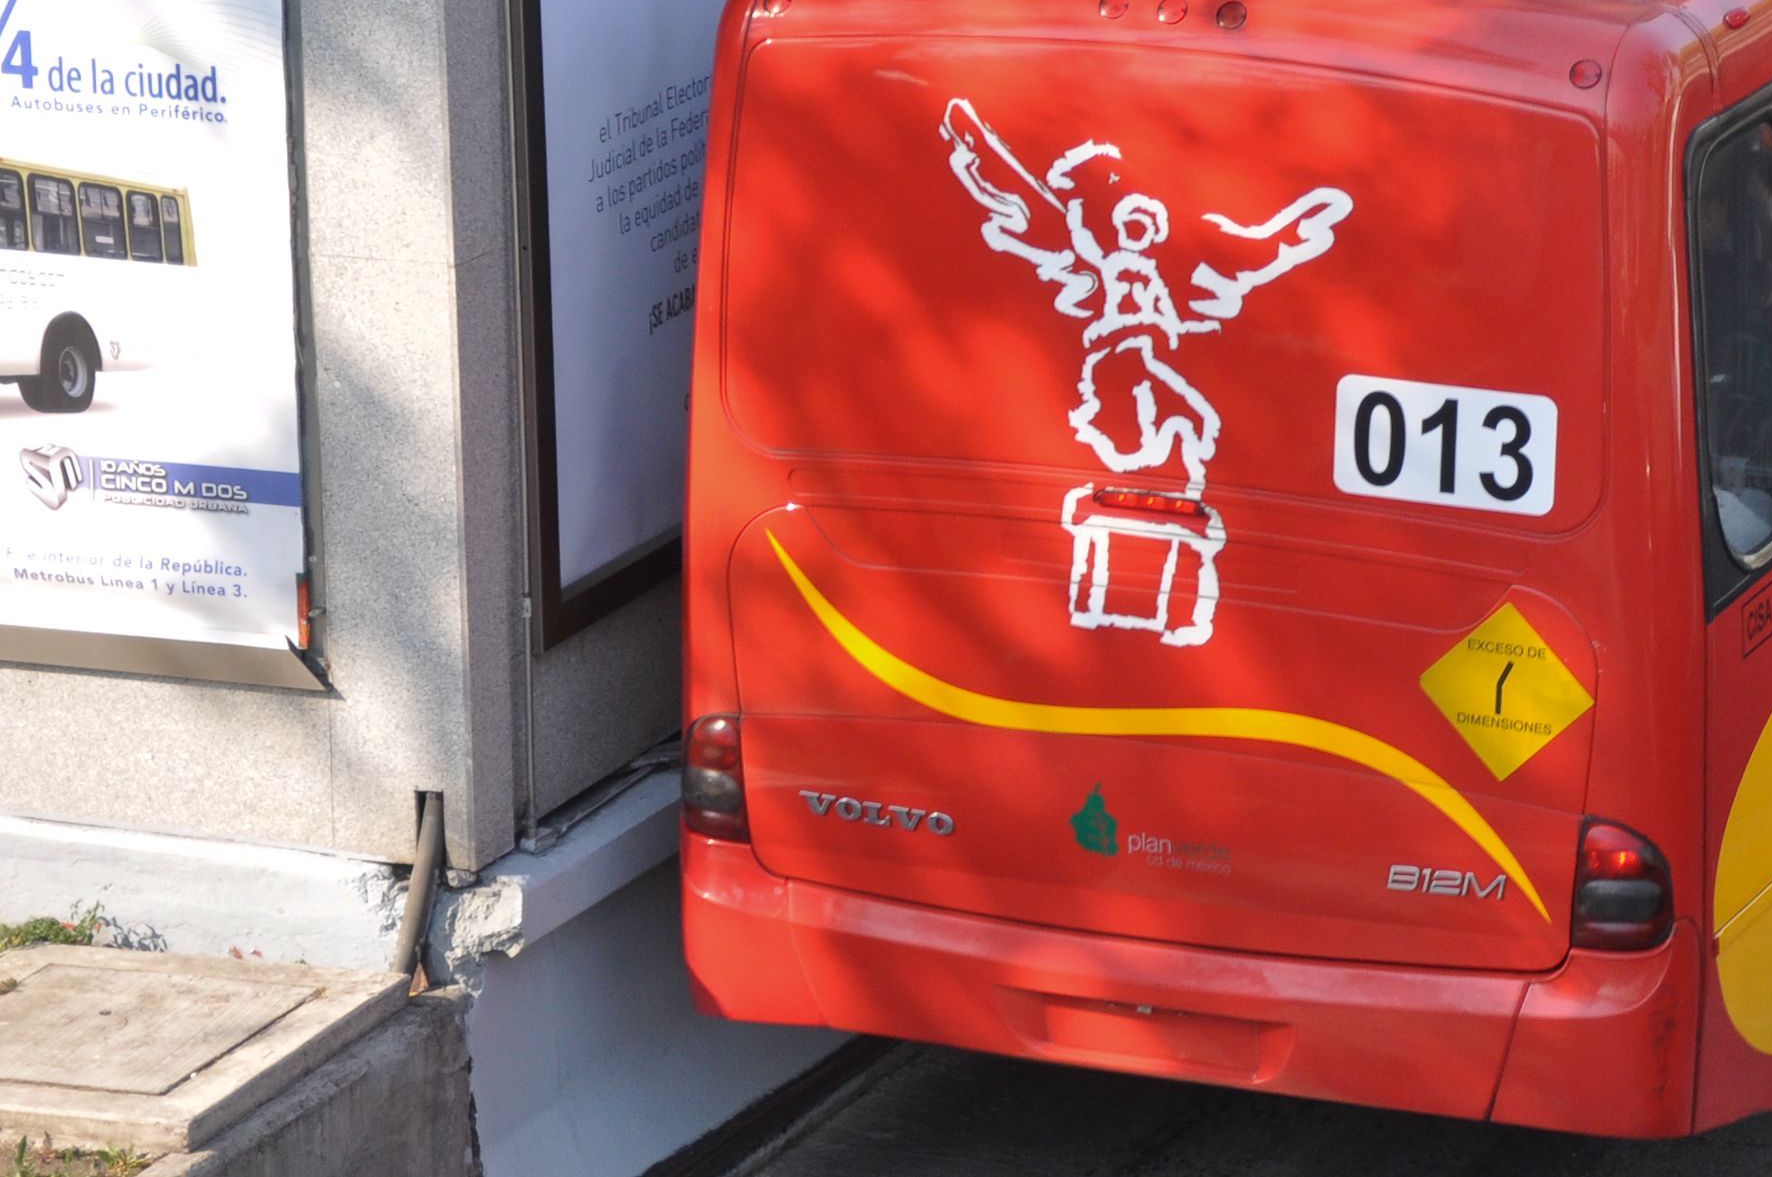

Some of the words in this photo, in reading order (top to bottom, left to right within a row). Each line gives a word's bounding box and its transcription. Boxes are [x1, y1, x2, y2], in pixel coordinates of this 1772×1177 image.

[48, 56, 82, 93] de
[92, 58, 114, 95] la
[124, 63, 226, 104] ciudad.
[10, 96, 103, 114] Autobuses
[111, 104, 130, 115] en
[139, 103, 228, 123] Periférico.
[599, 117, 612, 143] el
[614, 92, 664, 135] Tribunal
[588, 140, 637, 183] Judicial
[639, 133, 653, 157] de
[656, 127, 668, 149] la
[596, 195, 604, 213] a
[607, 184, 626, 207] los
[628, 158, 677, 203] partidos
[619, 213, 631, 235] la
[634, 183, 681, 228] equidad
[684, 177, 699, 201] de
[674, 250, 688, 273] de
[1354, 390, 1534, 501] 013
[101, 474, 168, 493] CINCO
[174, 480, 195, 495] M
[201, 483, 248, 500] DOS
[189, 499, 248, 514] URBANA
[44, 552, 104, 566] interor
[112, 555, 132, 568] de
[140, 557, 153, 570] la
[161, 557, 248, 577] República.
[151, 579, 158, 591] 1
[166, 582, 175, 595] y
[233, 584, 248, 598] 3.
[1467, 638, 1524, 658] EXCESO
[1527, 646, 1546, 660] DE
[1456, 711, 1553, 736] DIMENSIONES
[799, 790, 955, 836] VOLVO
[1387, 864, 1507, 901] B12M
